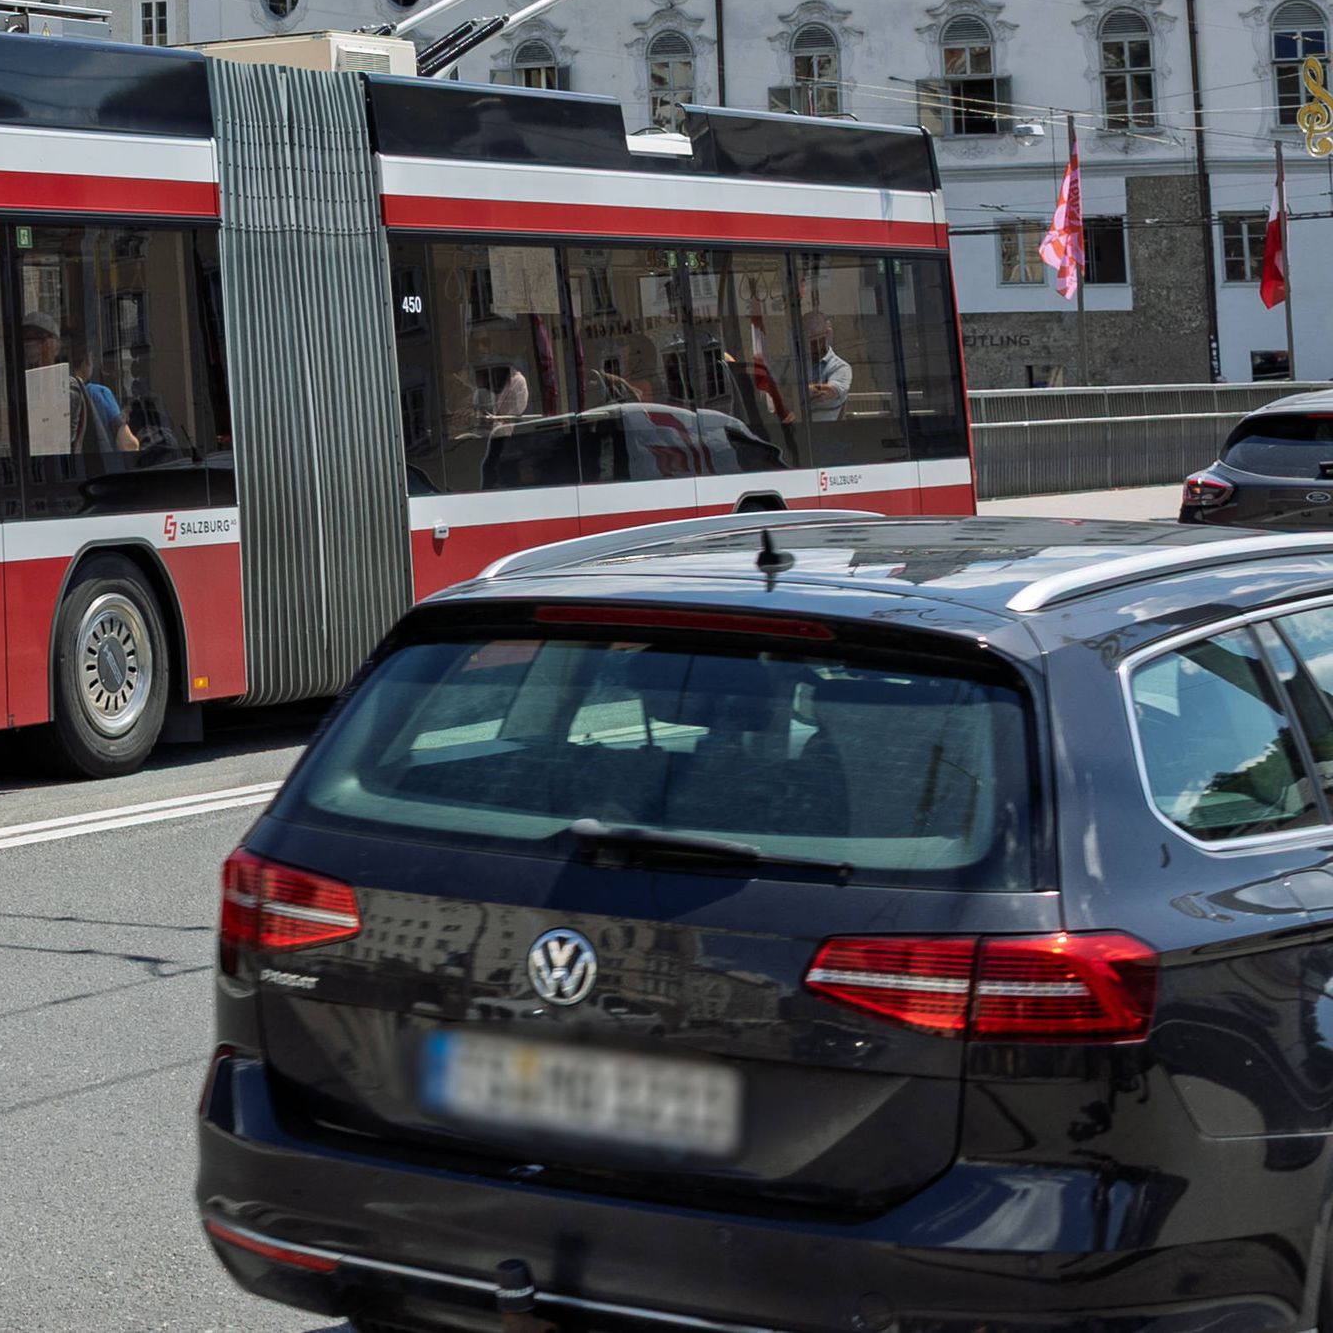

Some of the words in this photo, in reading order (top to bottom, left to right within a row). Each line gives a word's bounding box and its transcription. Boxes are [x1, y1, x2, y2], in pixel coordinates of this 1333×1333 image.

[402, 296, 422, 313] 450
[829, 474, 858, 486] SALZBURG
[180, 519, 230, 535] SALZBURG
